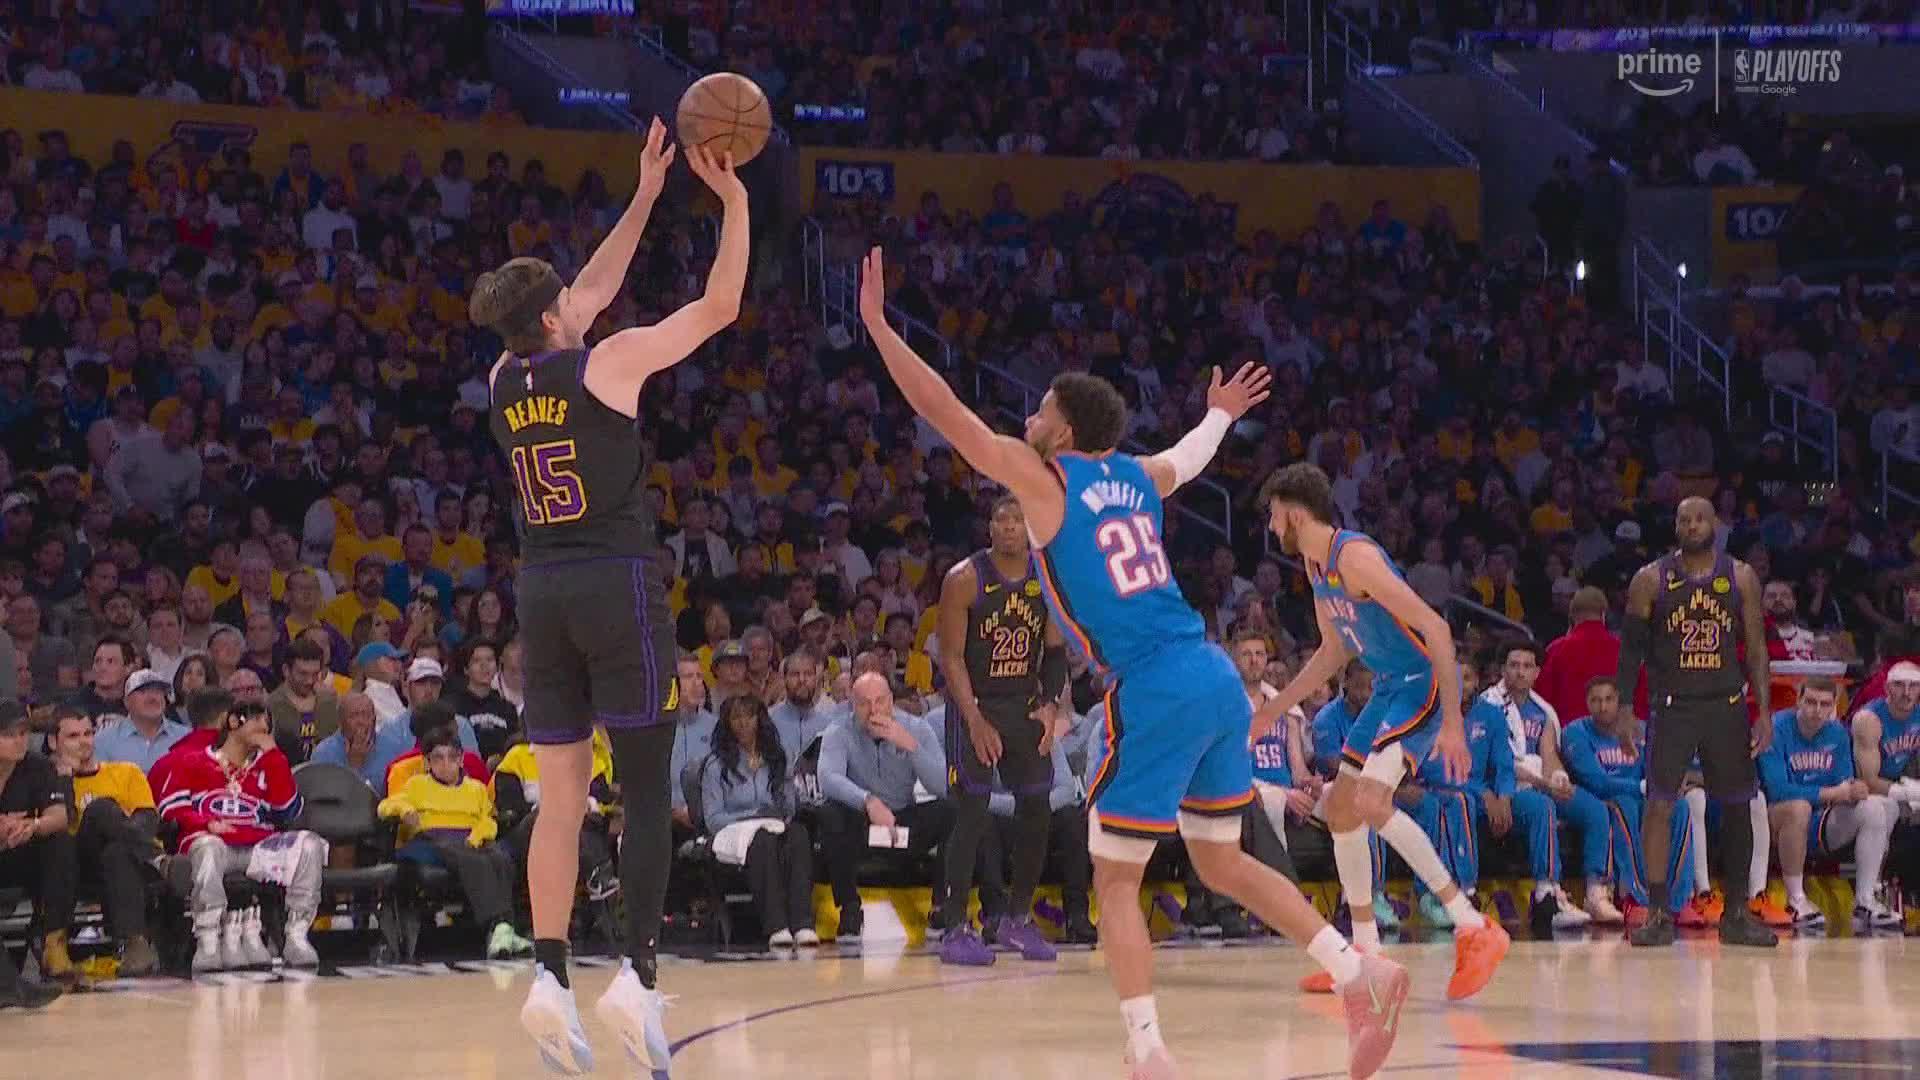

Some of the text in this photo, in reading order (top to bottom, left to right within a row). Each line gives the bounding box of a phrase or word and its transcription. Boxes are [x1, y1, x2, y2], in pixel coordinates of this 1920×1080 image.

[824, 166, 885, 194] 103
[504, 397, 568, 432] REAVES
[512, 439, 589, 524] 15
[1096, 513, 1169, 597] 25
[980, 611, 999, 640] LOS
[1667, 606, 1685, 632] LOS
[992, 627, 1030, 660] 28
[1681, 620, 1720, 652] 23
[990, 661, 1028, 678] LAKERS
[1680, 653, 1721, 669] LAKERS
[1255, 744, 1281, 769] 55
